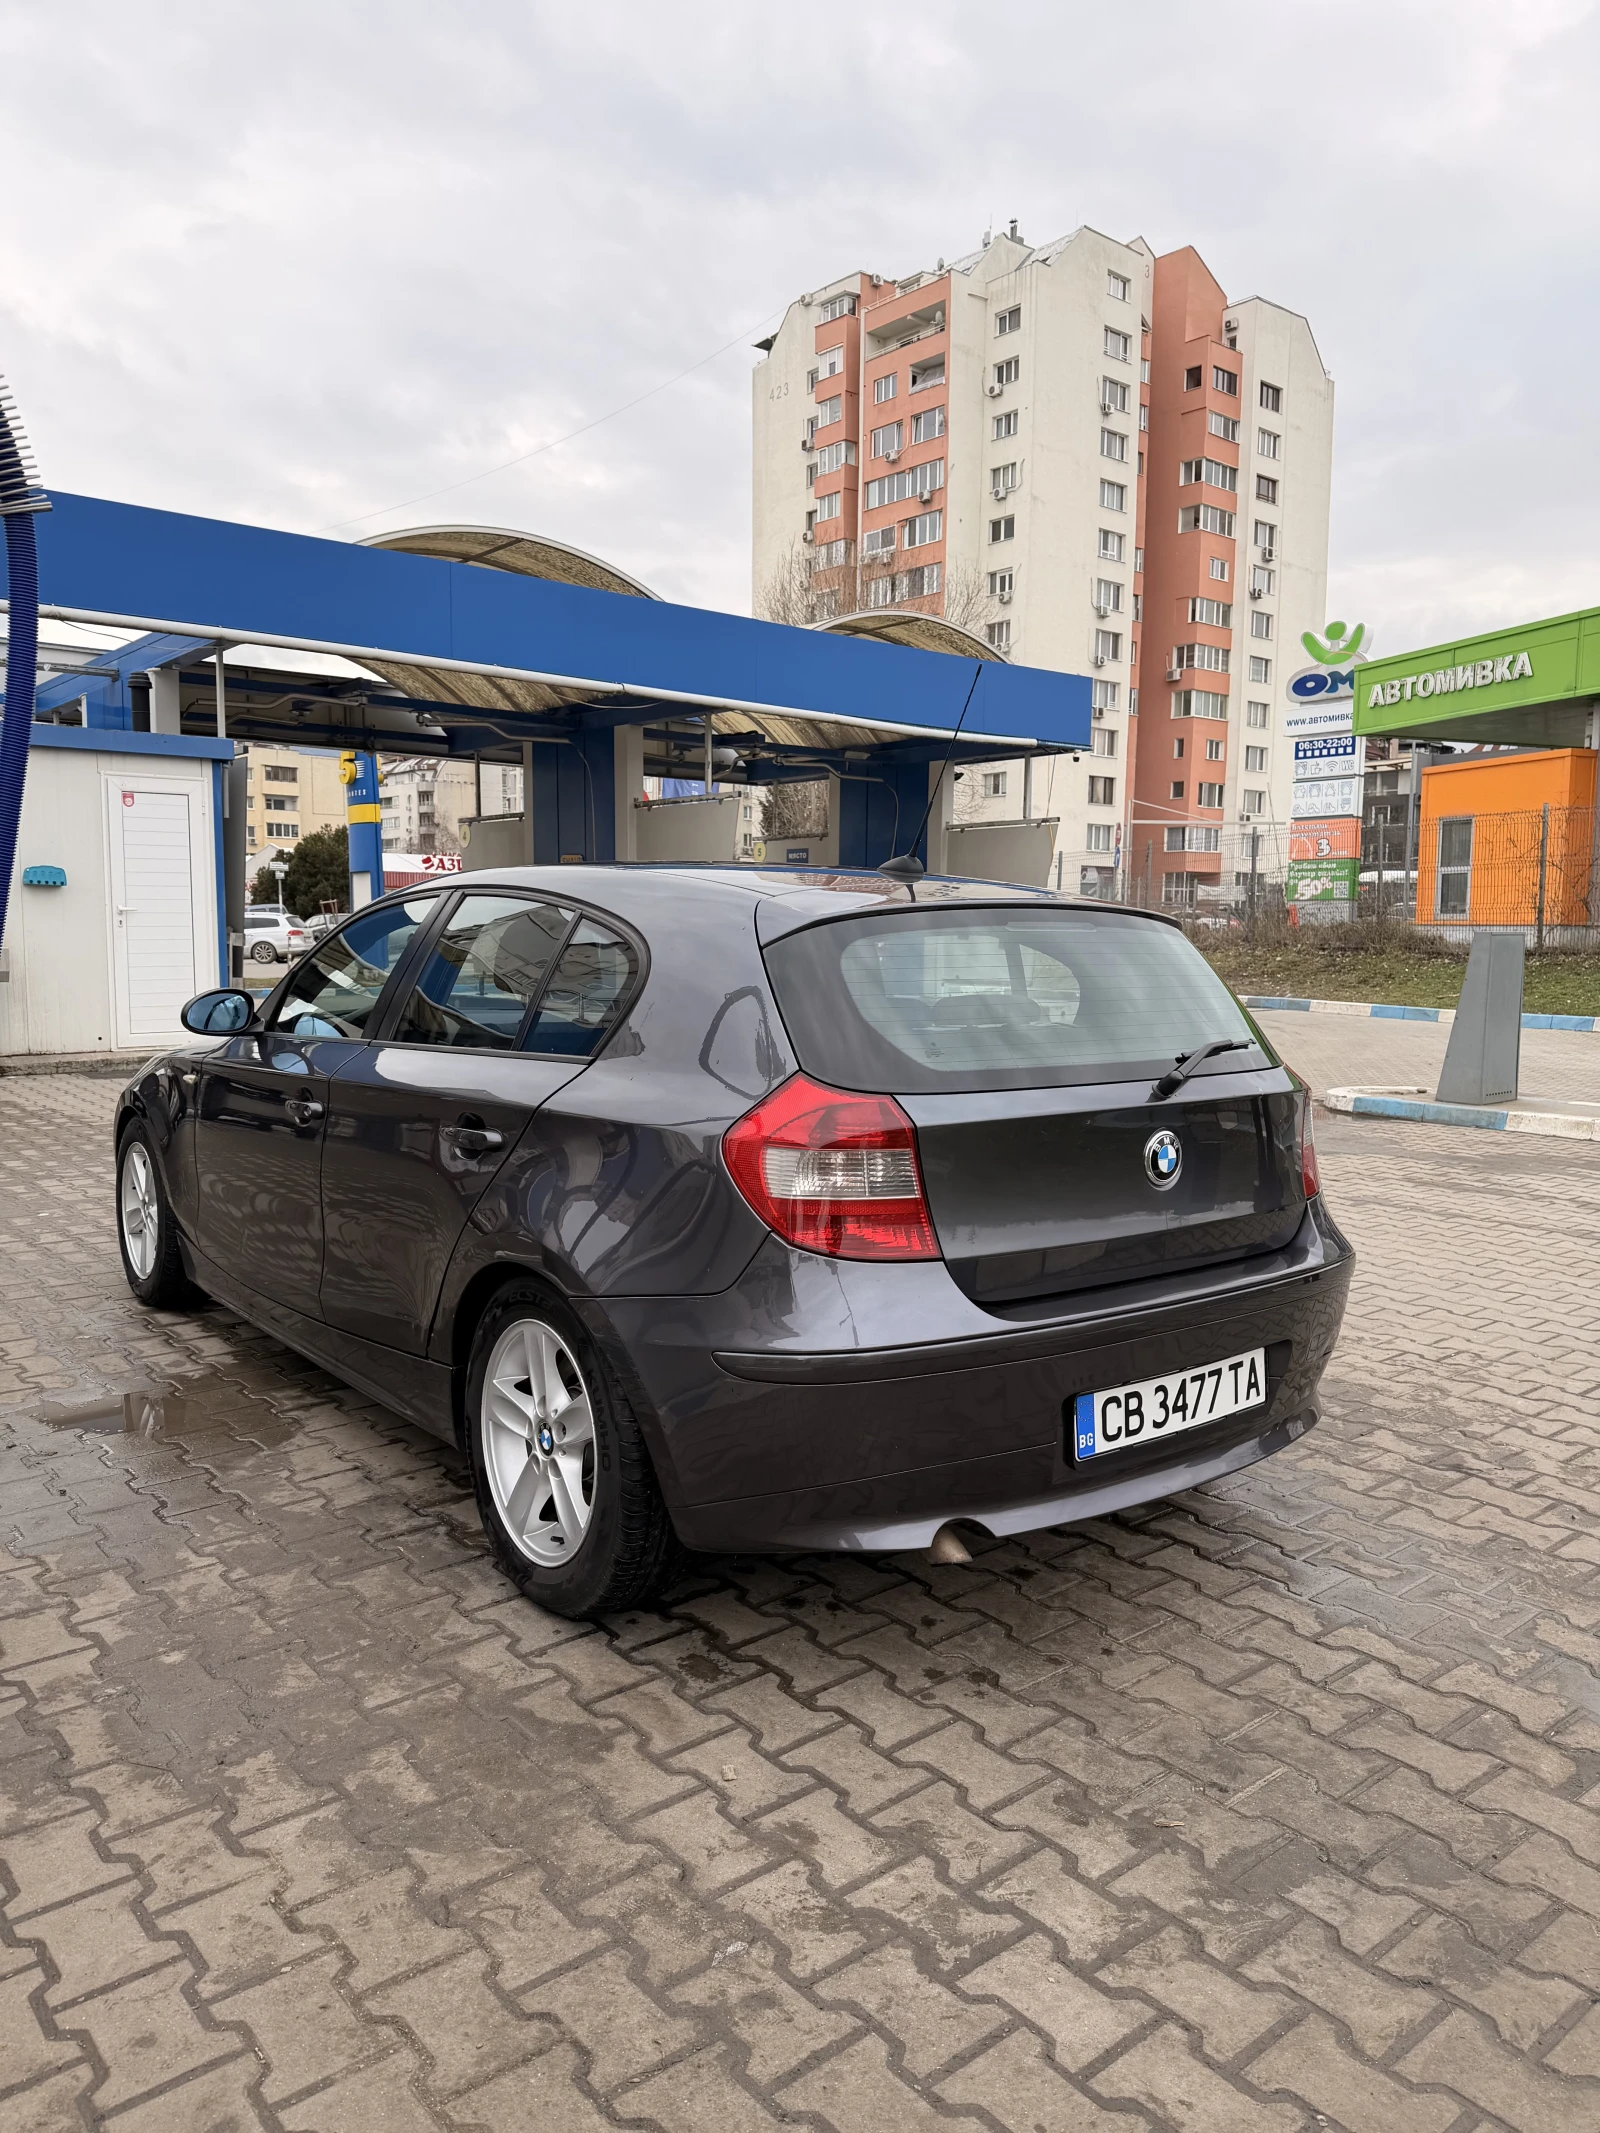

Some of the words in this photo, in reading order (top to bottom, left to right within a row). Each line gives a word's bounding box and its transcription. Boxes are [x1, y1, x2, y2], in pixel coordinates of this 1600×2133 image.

[769, 382, 789, 402] 423
[1368, 652, 1534, 708] АВТОМИВКА
[1299, 738, 1352, 750] 06:30-22:00
[1316, 838, 1332, 857] 3
[1295, 876, 1333, 900] 50%
[1153, 1136, 1179, 1153] BMW
[1101, 1390, 1145, 1442] CB
[1152, 1367, 1223, 1429] 3477
[1228, 1356, 1261, 1405] TA
[1079, 1432, 1094, 1449] BG
